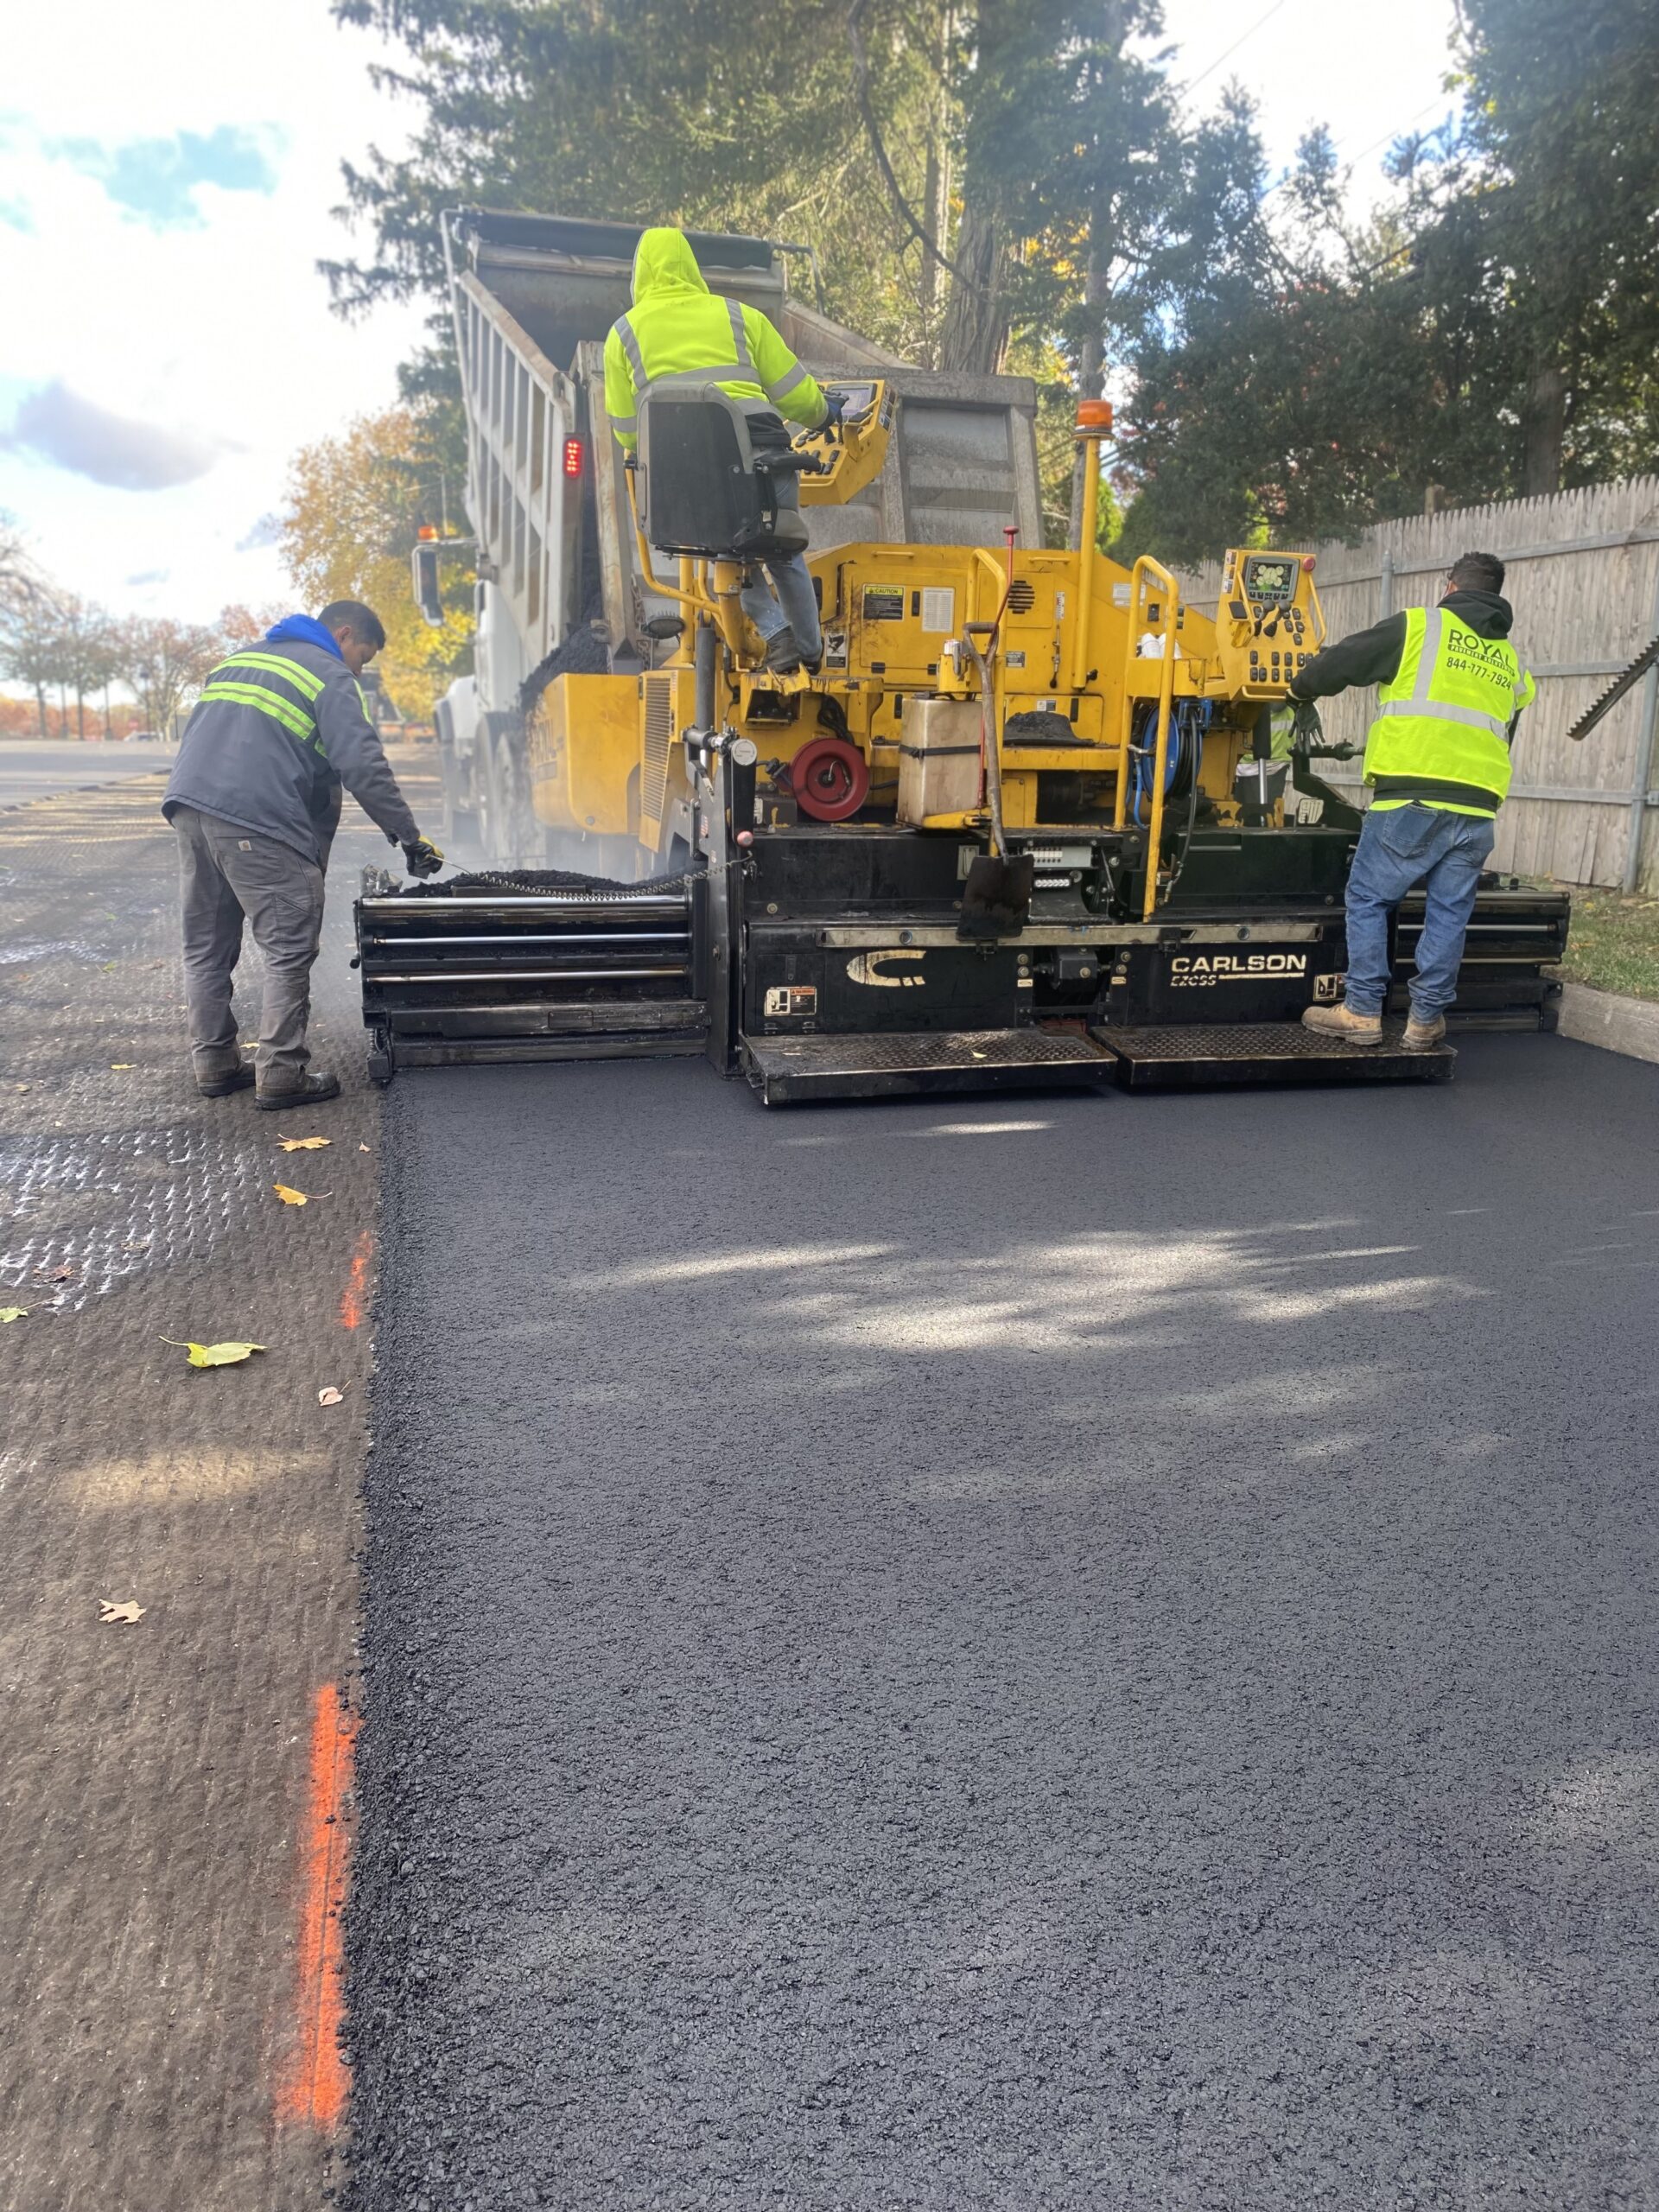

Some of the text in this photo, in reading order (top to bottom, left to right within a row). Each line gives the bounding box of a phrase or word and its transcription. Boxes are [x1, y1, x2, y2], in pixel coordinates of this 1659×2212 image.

[1448, 629, 1515, 671] ROYAL
[1446, 657, 1511, 690] 844-777-7924
[1172, 955, 1306, 973] CARLSON
